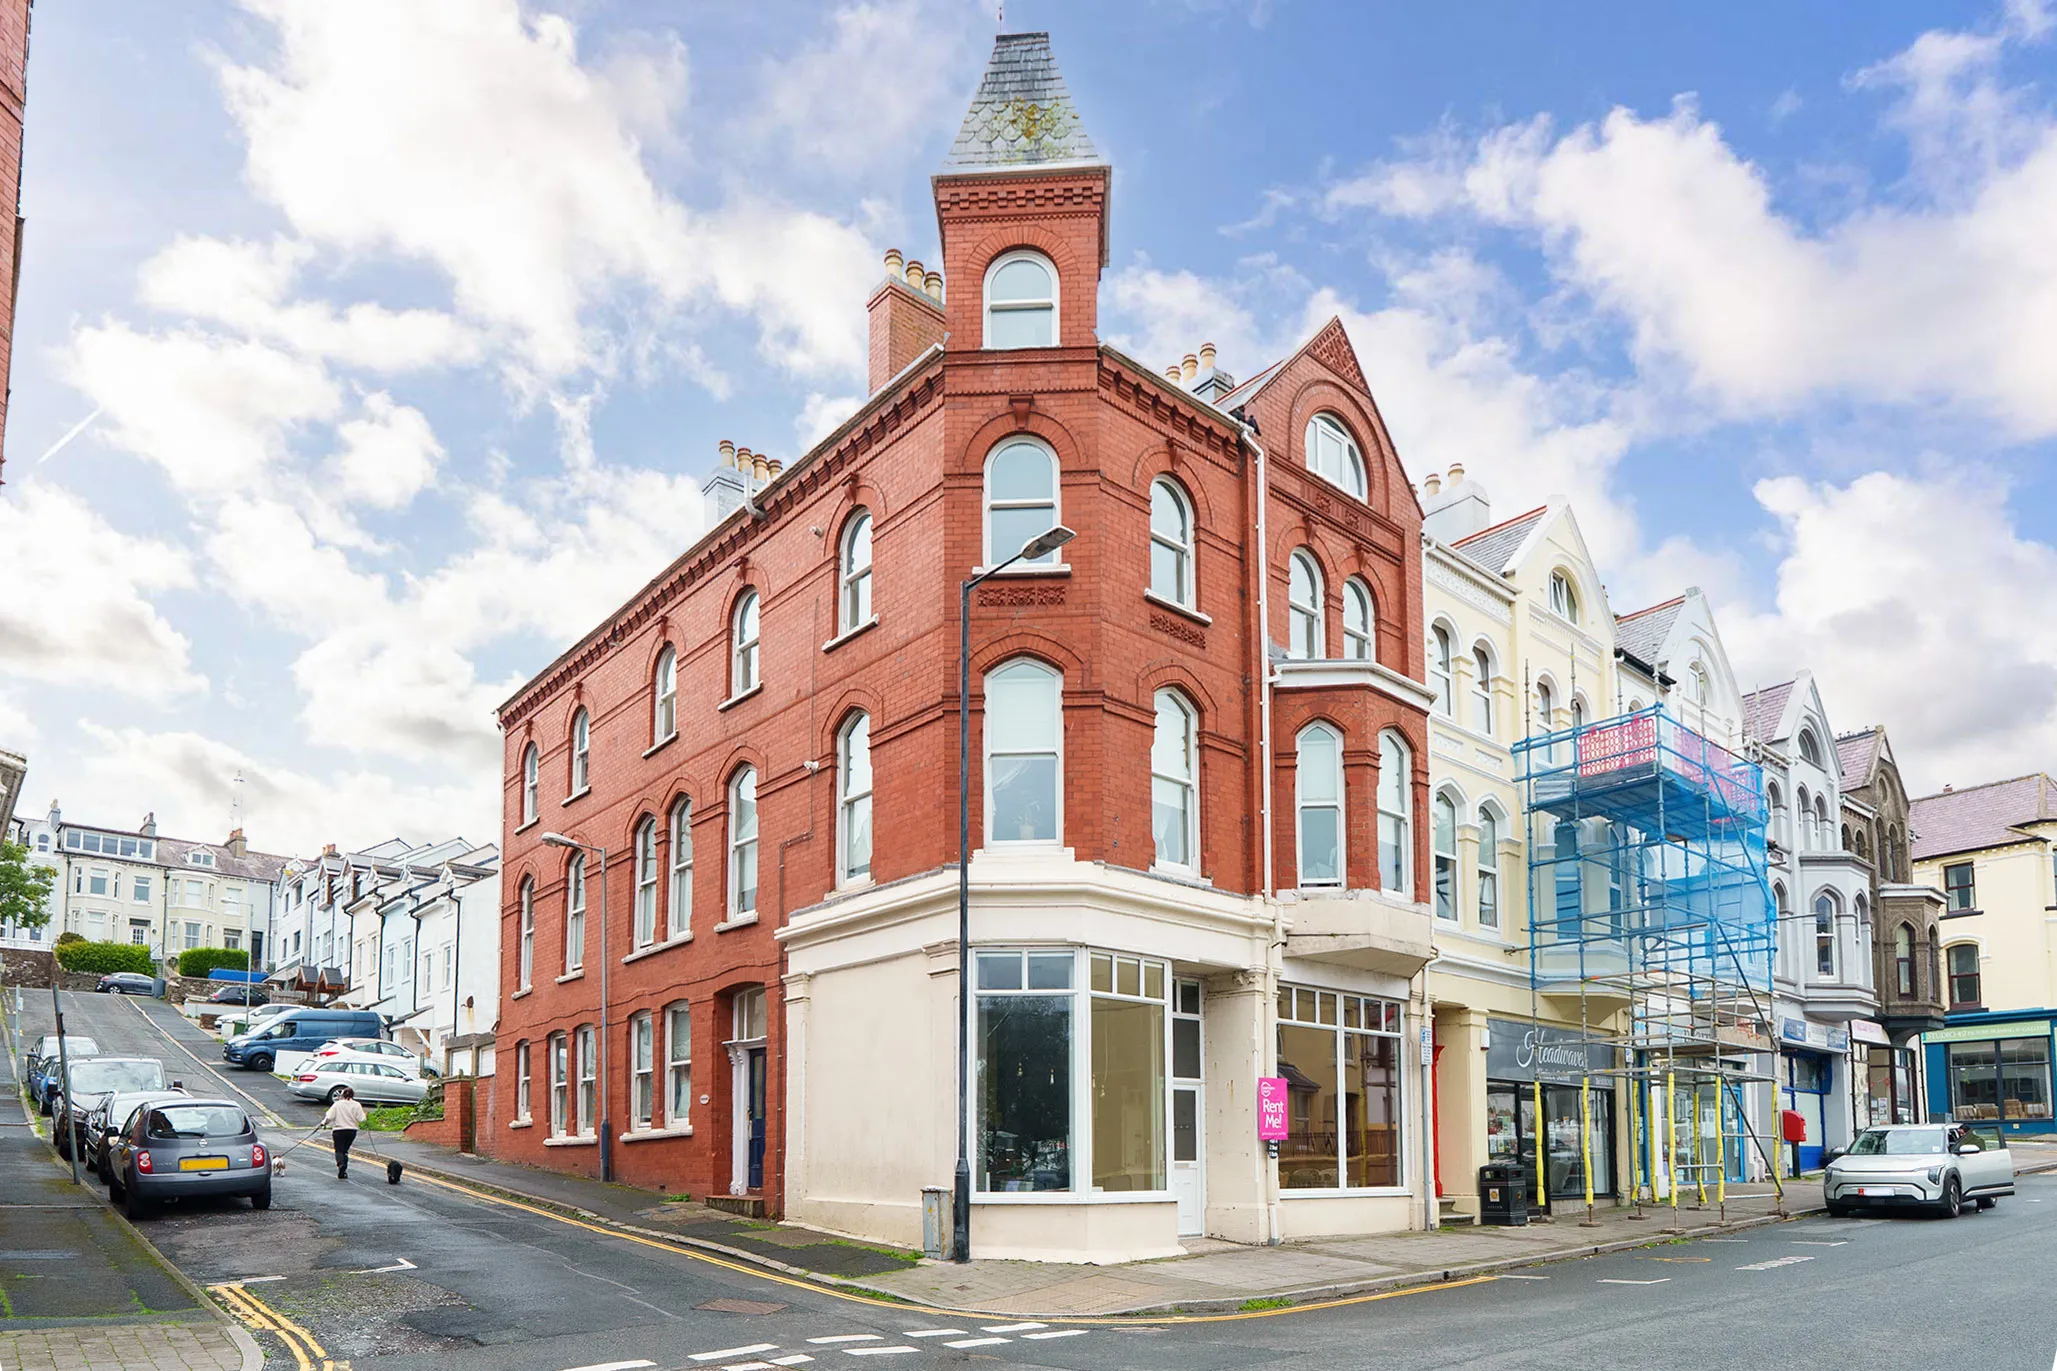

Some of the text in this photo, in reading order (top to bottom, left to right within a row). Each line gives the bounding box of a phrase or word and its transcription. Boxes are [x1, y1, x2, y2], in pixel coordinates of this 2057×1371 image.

[1516, 1030, 1586, 1067] Headwave
[1263, 1099, 1284, 1113] Rent
[1265, 1114, 1282, 1128] Me!
